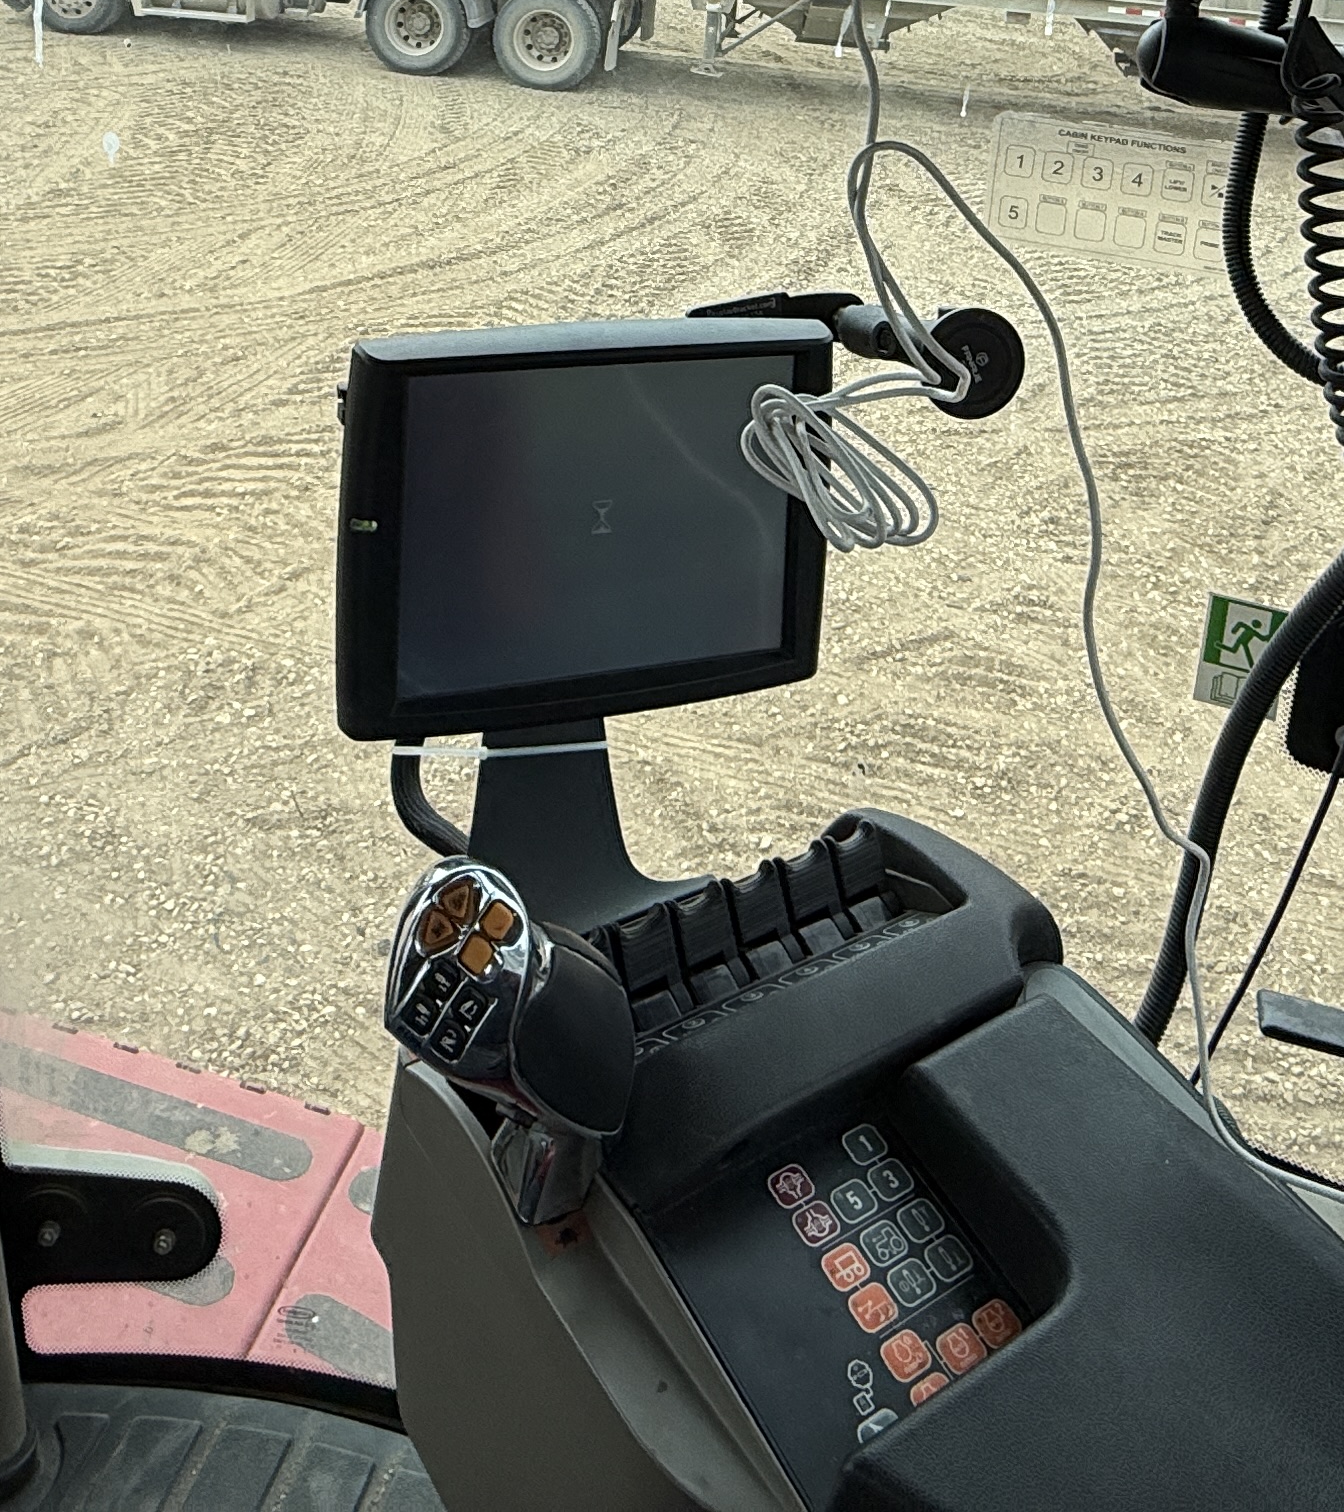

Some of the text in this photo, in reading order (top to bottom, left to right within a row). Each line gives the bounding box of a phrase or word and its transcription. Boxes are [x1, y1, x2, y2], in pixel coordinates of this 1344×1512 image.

[1058, 129, 1187, 155] CABIN KEYPAD FUNCTIONS
[1017, 155, 1024, 168] 1
[1053, 160, 1065, 175] 2
[1092, 167, 1103, 181] 3
[1132, 173, 1143, 187] 4
[1165, 184, 1187, 192] LOWER
[1008, 205, 1019, 219] 5
[1157, 236, 1183, 245] MASTER
[858, 1135, 873, 1153] 1
[882, 1170, 900, 1189] 3
[848, 1193, 864, 1210] 5
[958, 1328, 968, 1339] 1
